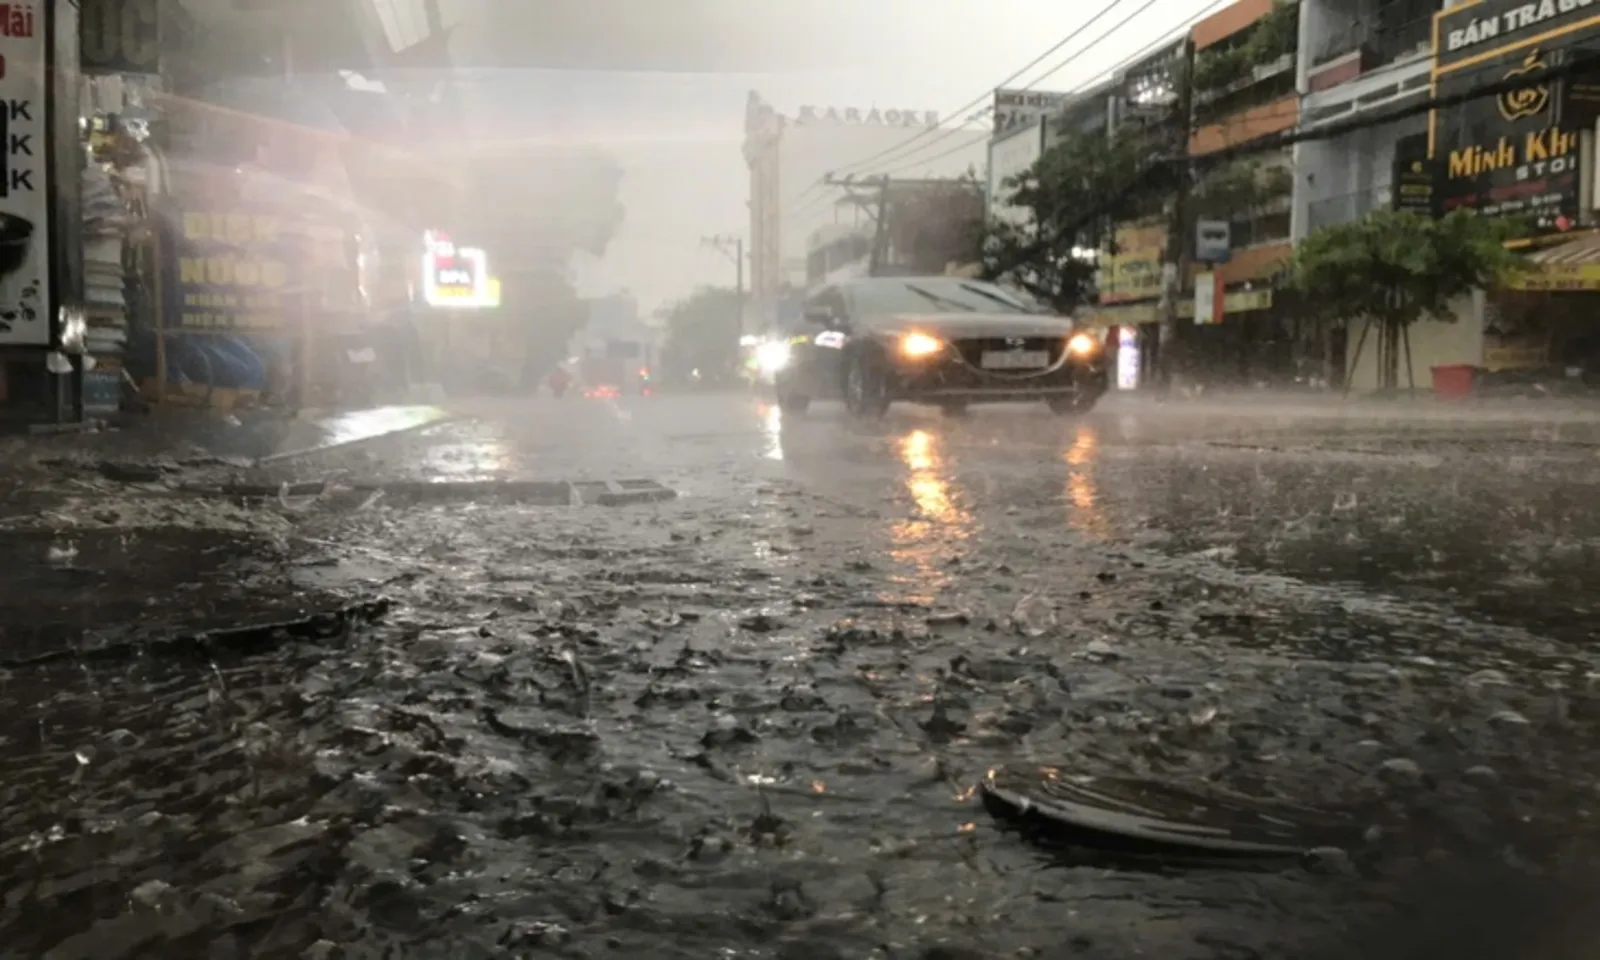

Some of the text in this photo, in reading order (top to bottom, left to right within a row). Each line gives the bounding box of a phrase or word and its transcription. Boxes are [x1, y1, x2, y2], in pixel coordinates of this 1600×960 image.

[1448, 17, 1499, 50] BÁN
[795, 103, 939, 128] KARAOKE
[1448, 136, 1514, 180] Minh
[439, 269, 471, 285] SPA
